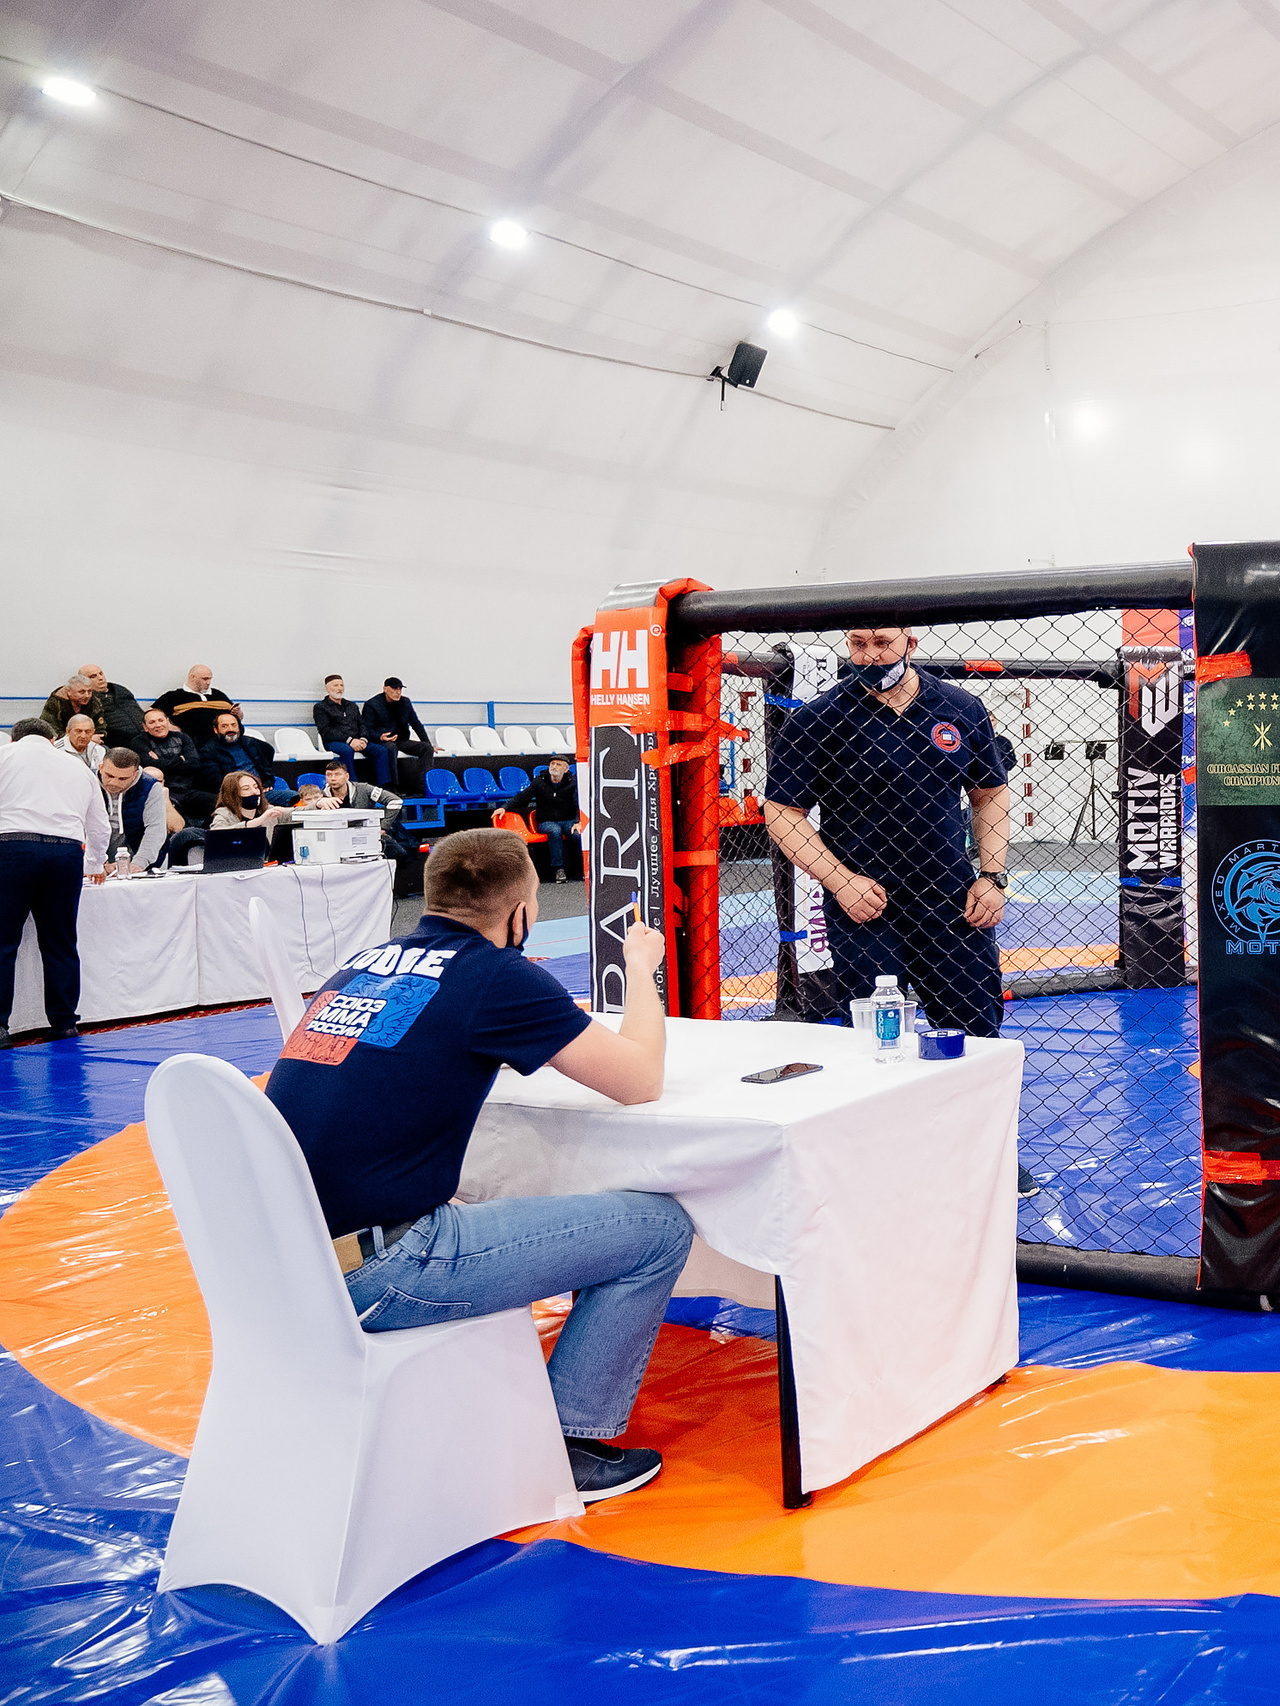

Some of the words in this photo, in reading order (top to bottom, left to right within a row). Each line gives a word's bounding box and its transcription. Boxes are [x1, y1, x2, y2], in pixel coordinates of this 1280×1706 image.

[591, 629, 649, 690] HH
[590, 693, 616, 706] HELLY
[616, 692, 650, 706] HANSEN
[1207, 762, 1270, 774] CIRCASSIAN
[648, 797, 659, 831] Для
[1126, 767, 1159, 872] MOTIV
[600, 727, 642, 1014] PART
[649, 835, 661, 898] Лучшее
[1215, 875, 1241, 934] MIXED
[314, 1006, 372, 1028] ММА
[328, 994, 388, 1013] СОЮЗ
[305, 1020, 365, 1038] РОССИИ
